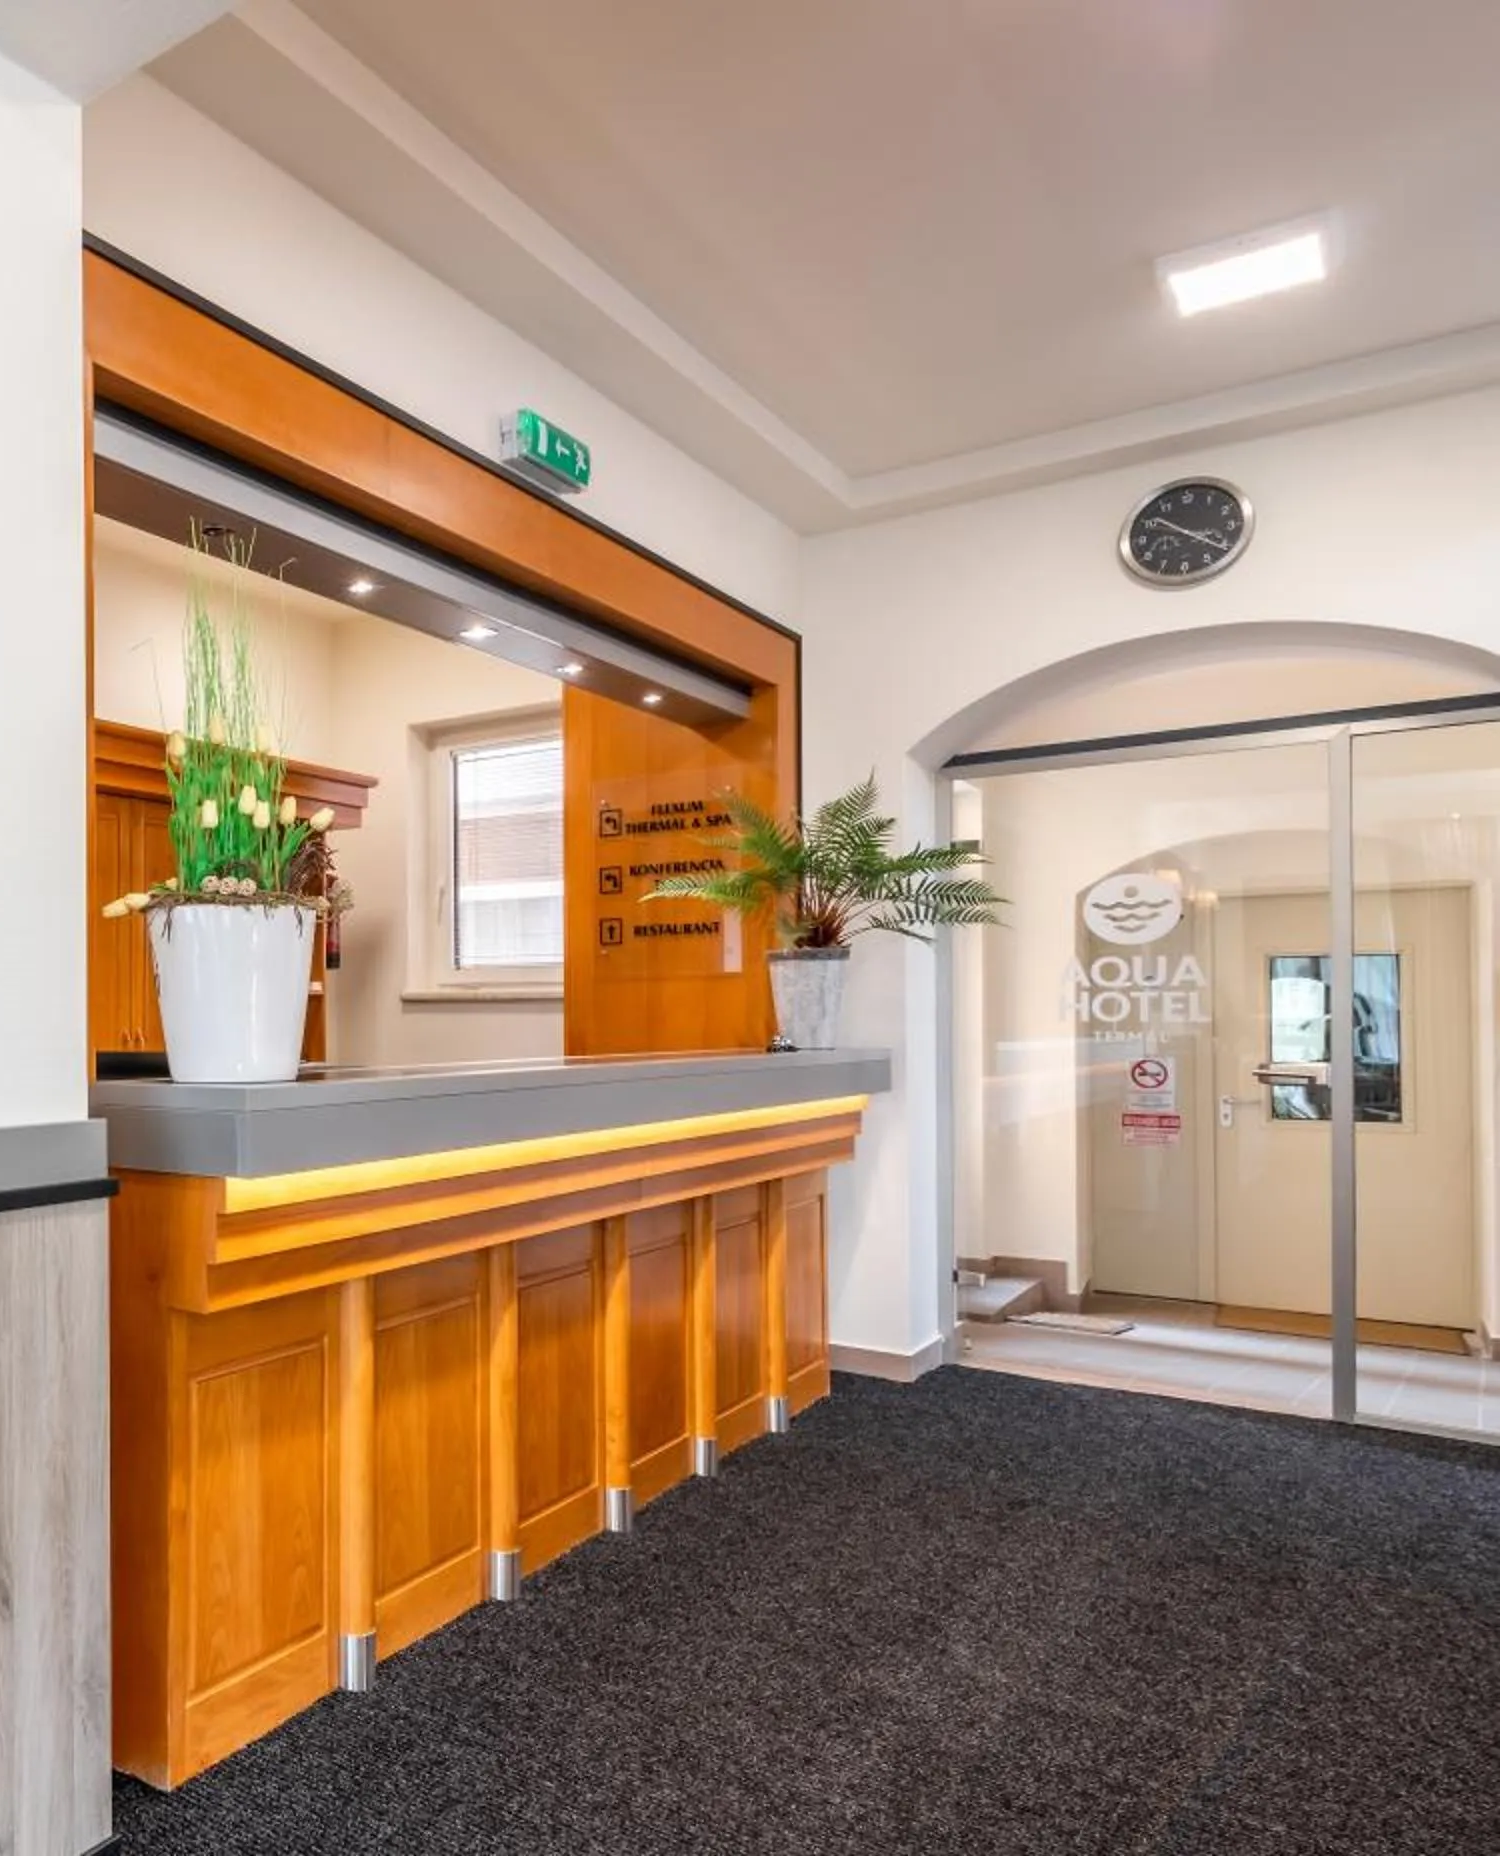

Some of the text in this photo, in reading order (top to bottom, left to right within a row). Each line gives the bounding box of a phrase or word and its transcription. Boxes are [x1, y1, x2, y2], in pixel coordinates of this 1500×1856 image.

[626, 813, 731, 833] THERMAL & SPA
[630, 859, 724, 875] KONFERENCIA
[634, 922, 719, 936] RESTAURANT
[1061, 955, 1207, 988] AQUA
[1058, 990, 1212, 1023] HOTEL
